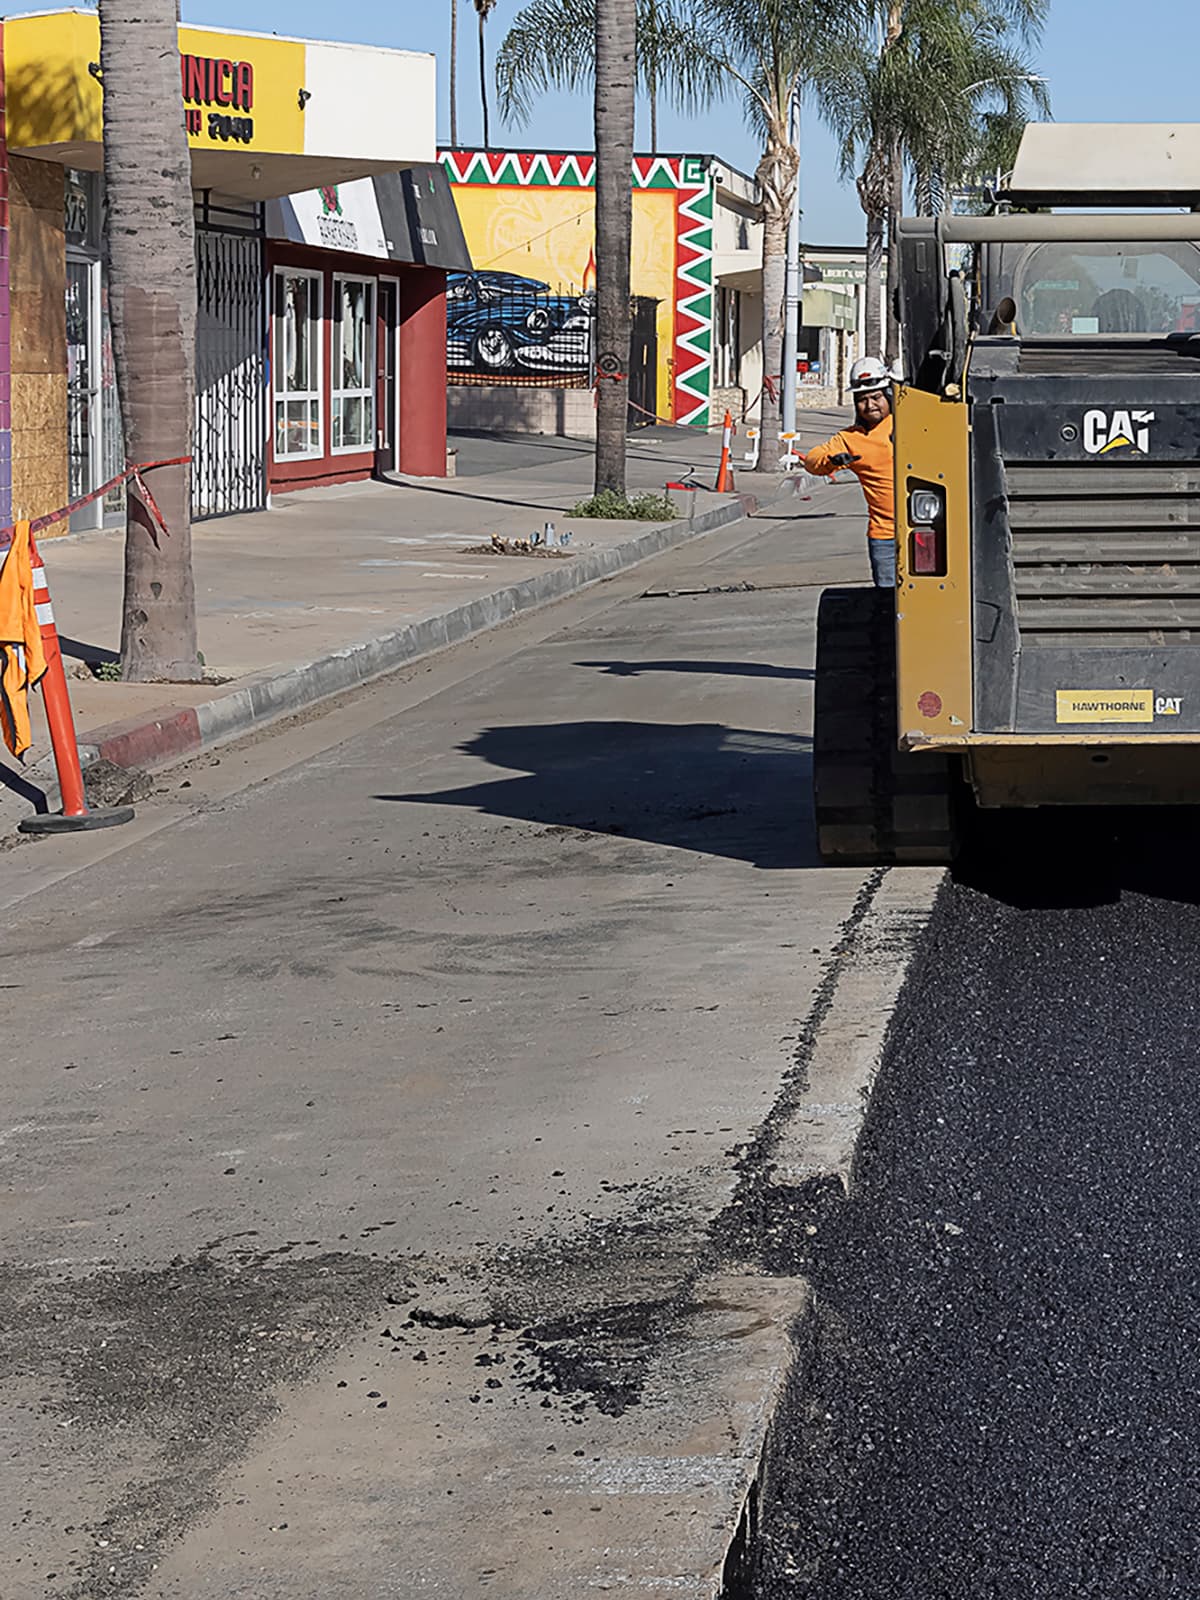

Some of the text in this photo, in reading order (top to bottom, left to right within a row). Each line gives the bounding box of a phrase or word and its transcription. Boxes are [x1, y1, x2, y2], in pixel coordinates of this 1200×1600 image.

[1083, 410, 1154, 454] CAT
[1072, 697, 1184, 714] HAWTHORNE CAT
